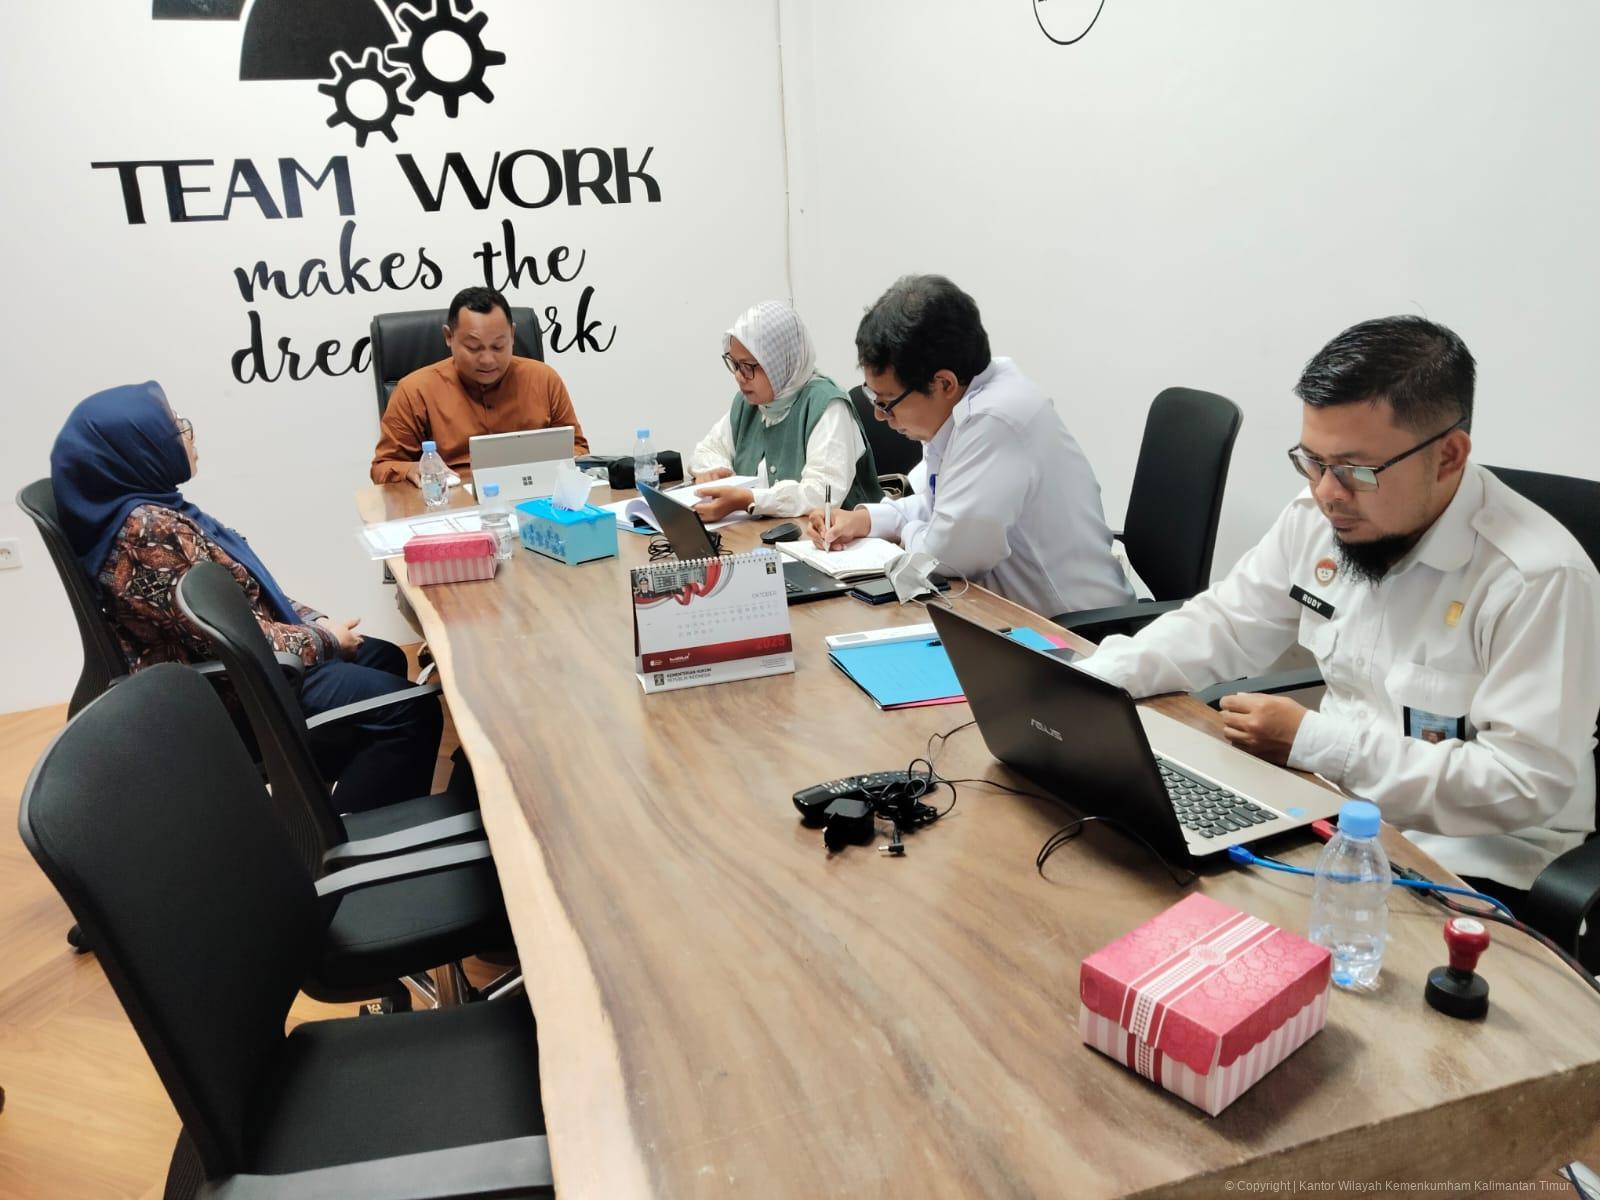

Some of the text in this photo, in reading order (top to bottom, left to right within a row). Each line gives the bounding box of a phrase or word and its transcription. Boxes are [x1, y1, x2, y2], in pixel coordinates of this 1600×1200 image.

[91, 146, 661, 225] TEAM WORK
[233, 219, 586, 302] makes the
[1302, 593, 1322, 609] RUDY
[1031, 718, 1063, 741] ASUS
